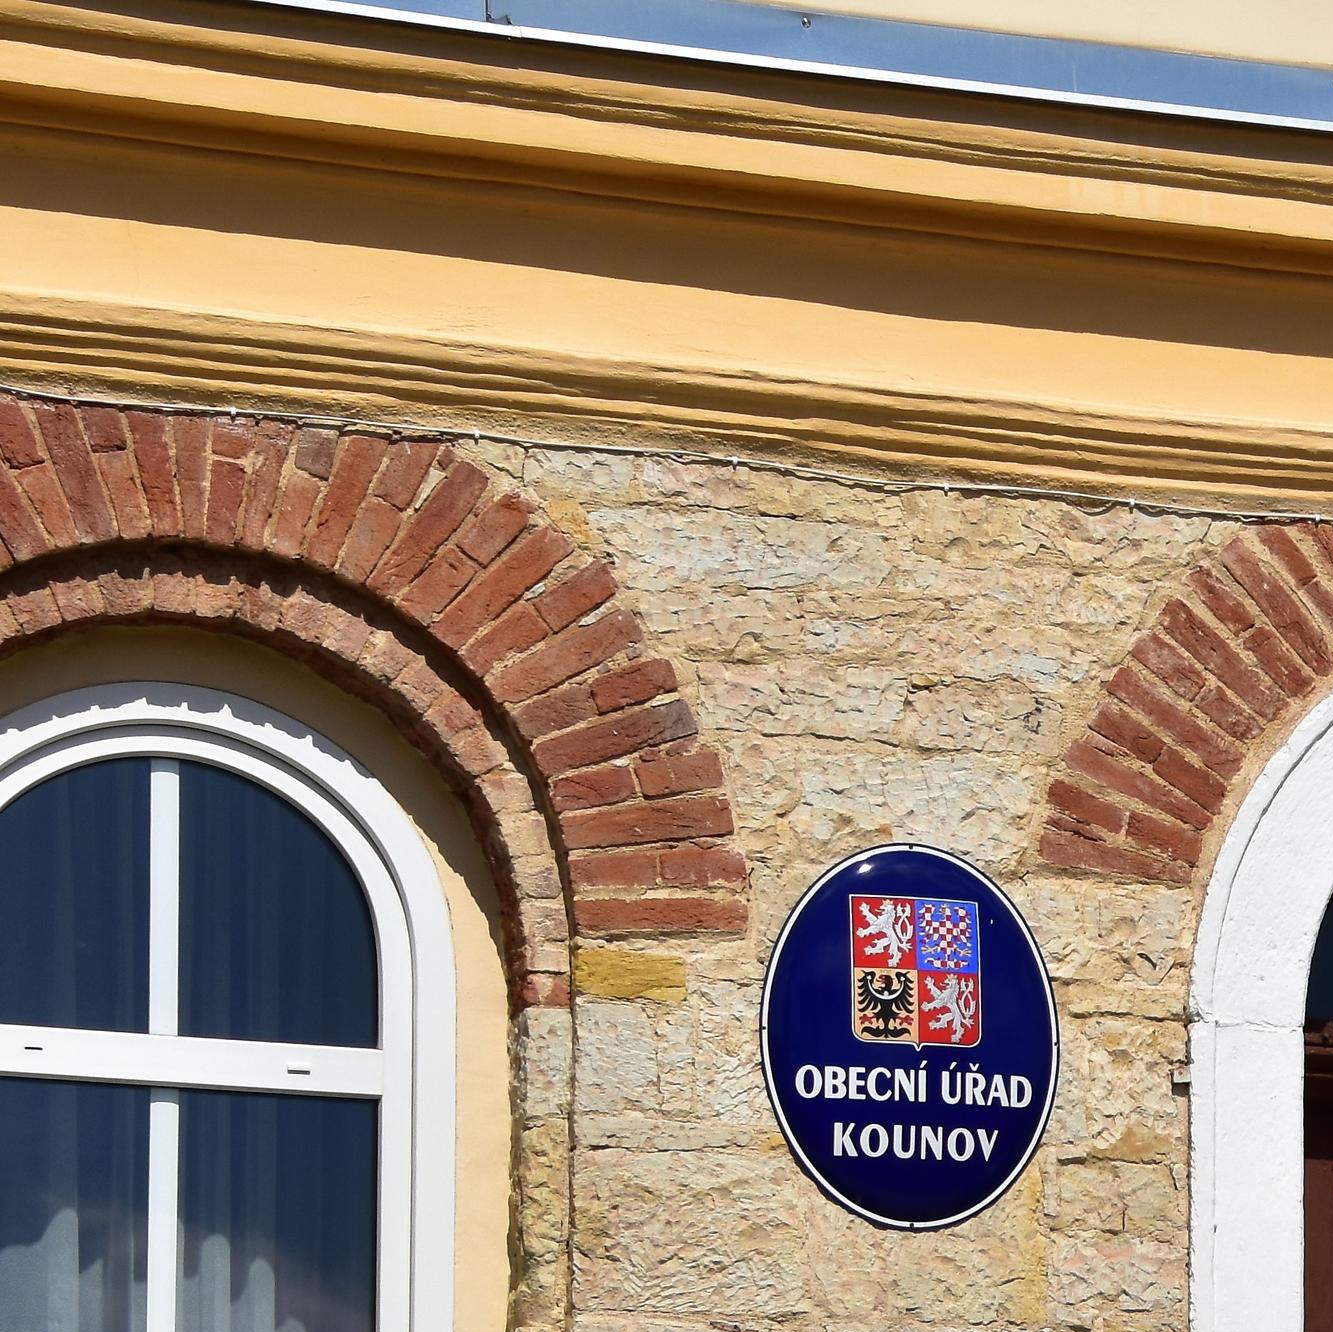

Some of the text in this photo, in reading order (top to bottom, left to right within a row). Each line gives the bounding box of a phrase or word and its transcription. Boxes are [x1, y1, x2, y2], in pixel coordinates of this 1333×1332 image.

[794, 1059, 1033, 1109] OBECNÍ ÚŘAD
[832, 1121, 999, 1163] KOUNOV
